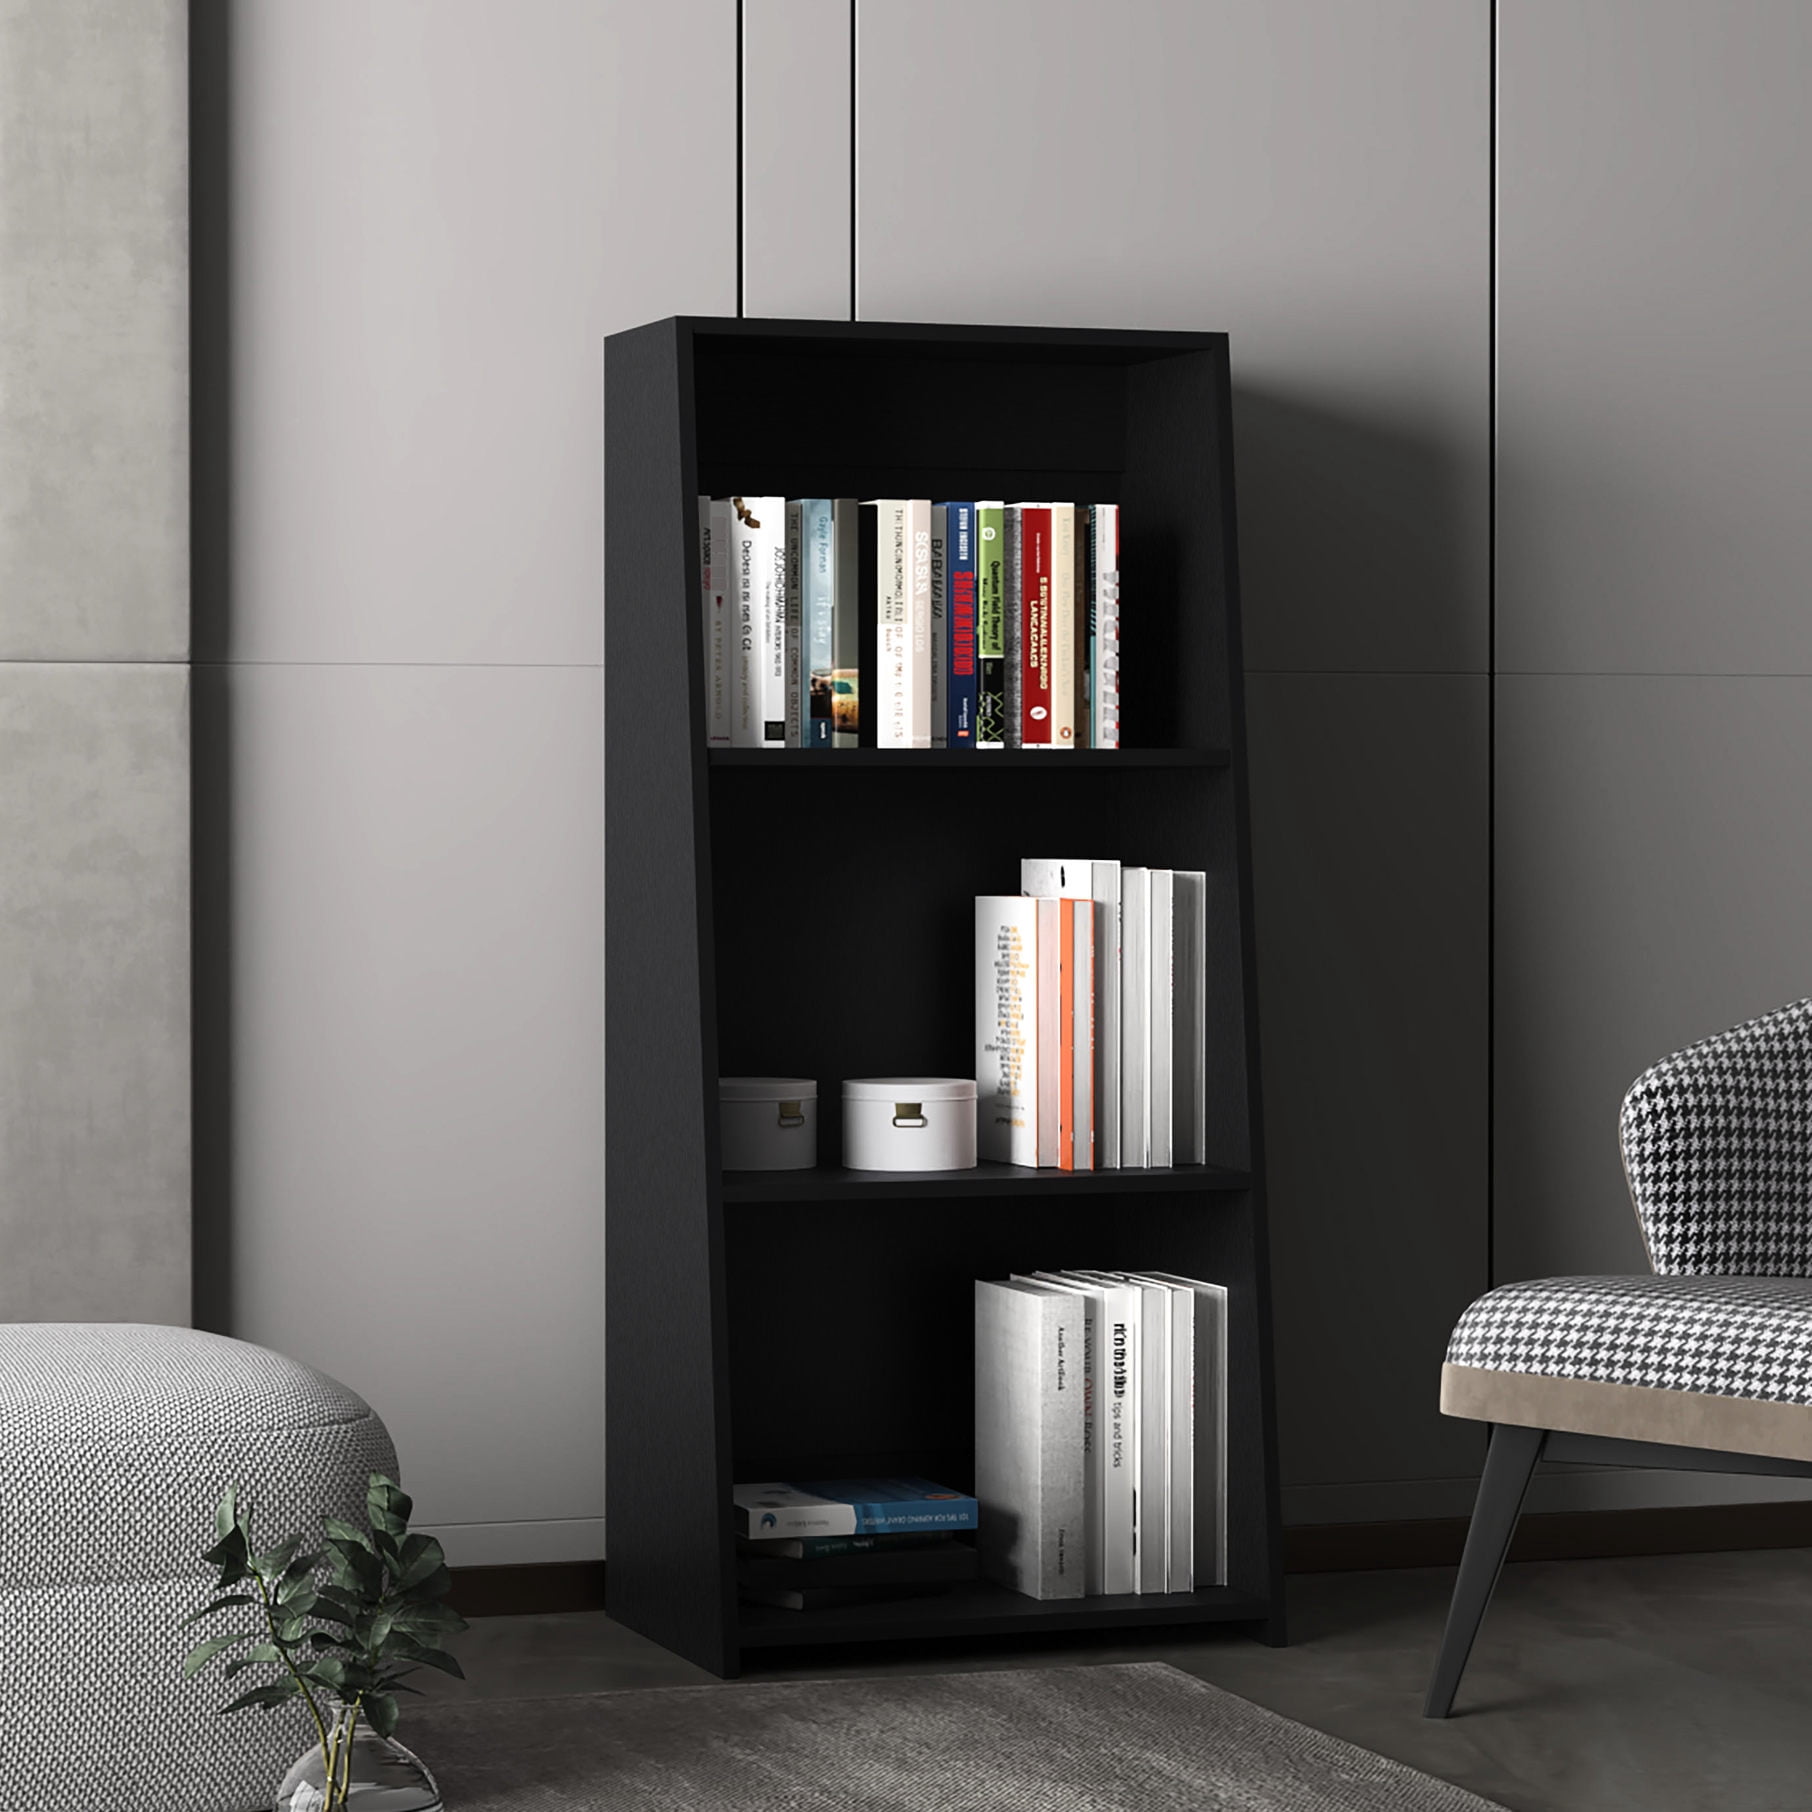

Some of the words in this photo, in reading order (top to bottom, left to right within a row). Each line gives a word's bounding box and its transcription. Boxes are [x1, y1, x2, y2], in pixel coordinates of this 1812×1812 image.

[791, 513, 799, 530] THE
[818, 517, 828, 539] Gayle
[791, 538, 799, 590] UNCOMMON
[819, 542, 827, 573] Forman
[990, 561, 1000, 594] Quantum
[791, 596, 799, 620] LIFE
[992, 597, 1000, 614] Field
[791, 628, 799, 639] OF
[988, 616, 1000, 641] Theory
[915, 634, 924, 653] LOS
[791, 647, 799, 685] COMMON
[791, 692, 799, 737] OBJECTS
[1085, 1378, 1093, 1417] OWN
[1112, 1402, 1122, 1419] tips
[1113, 1422, 1122, 1439] and
[1113, 1442, 1122, 1468] tricks
[935, 1514, 946, 1522] FOR
[946, 1513, 957, 1522] TIPS
